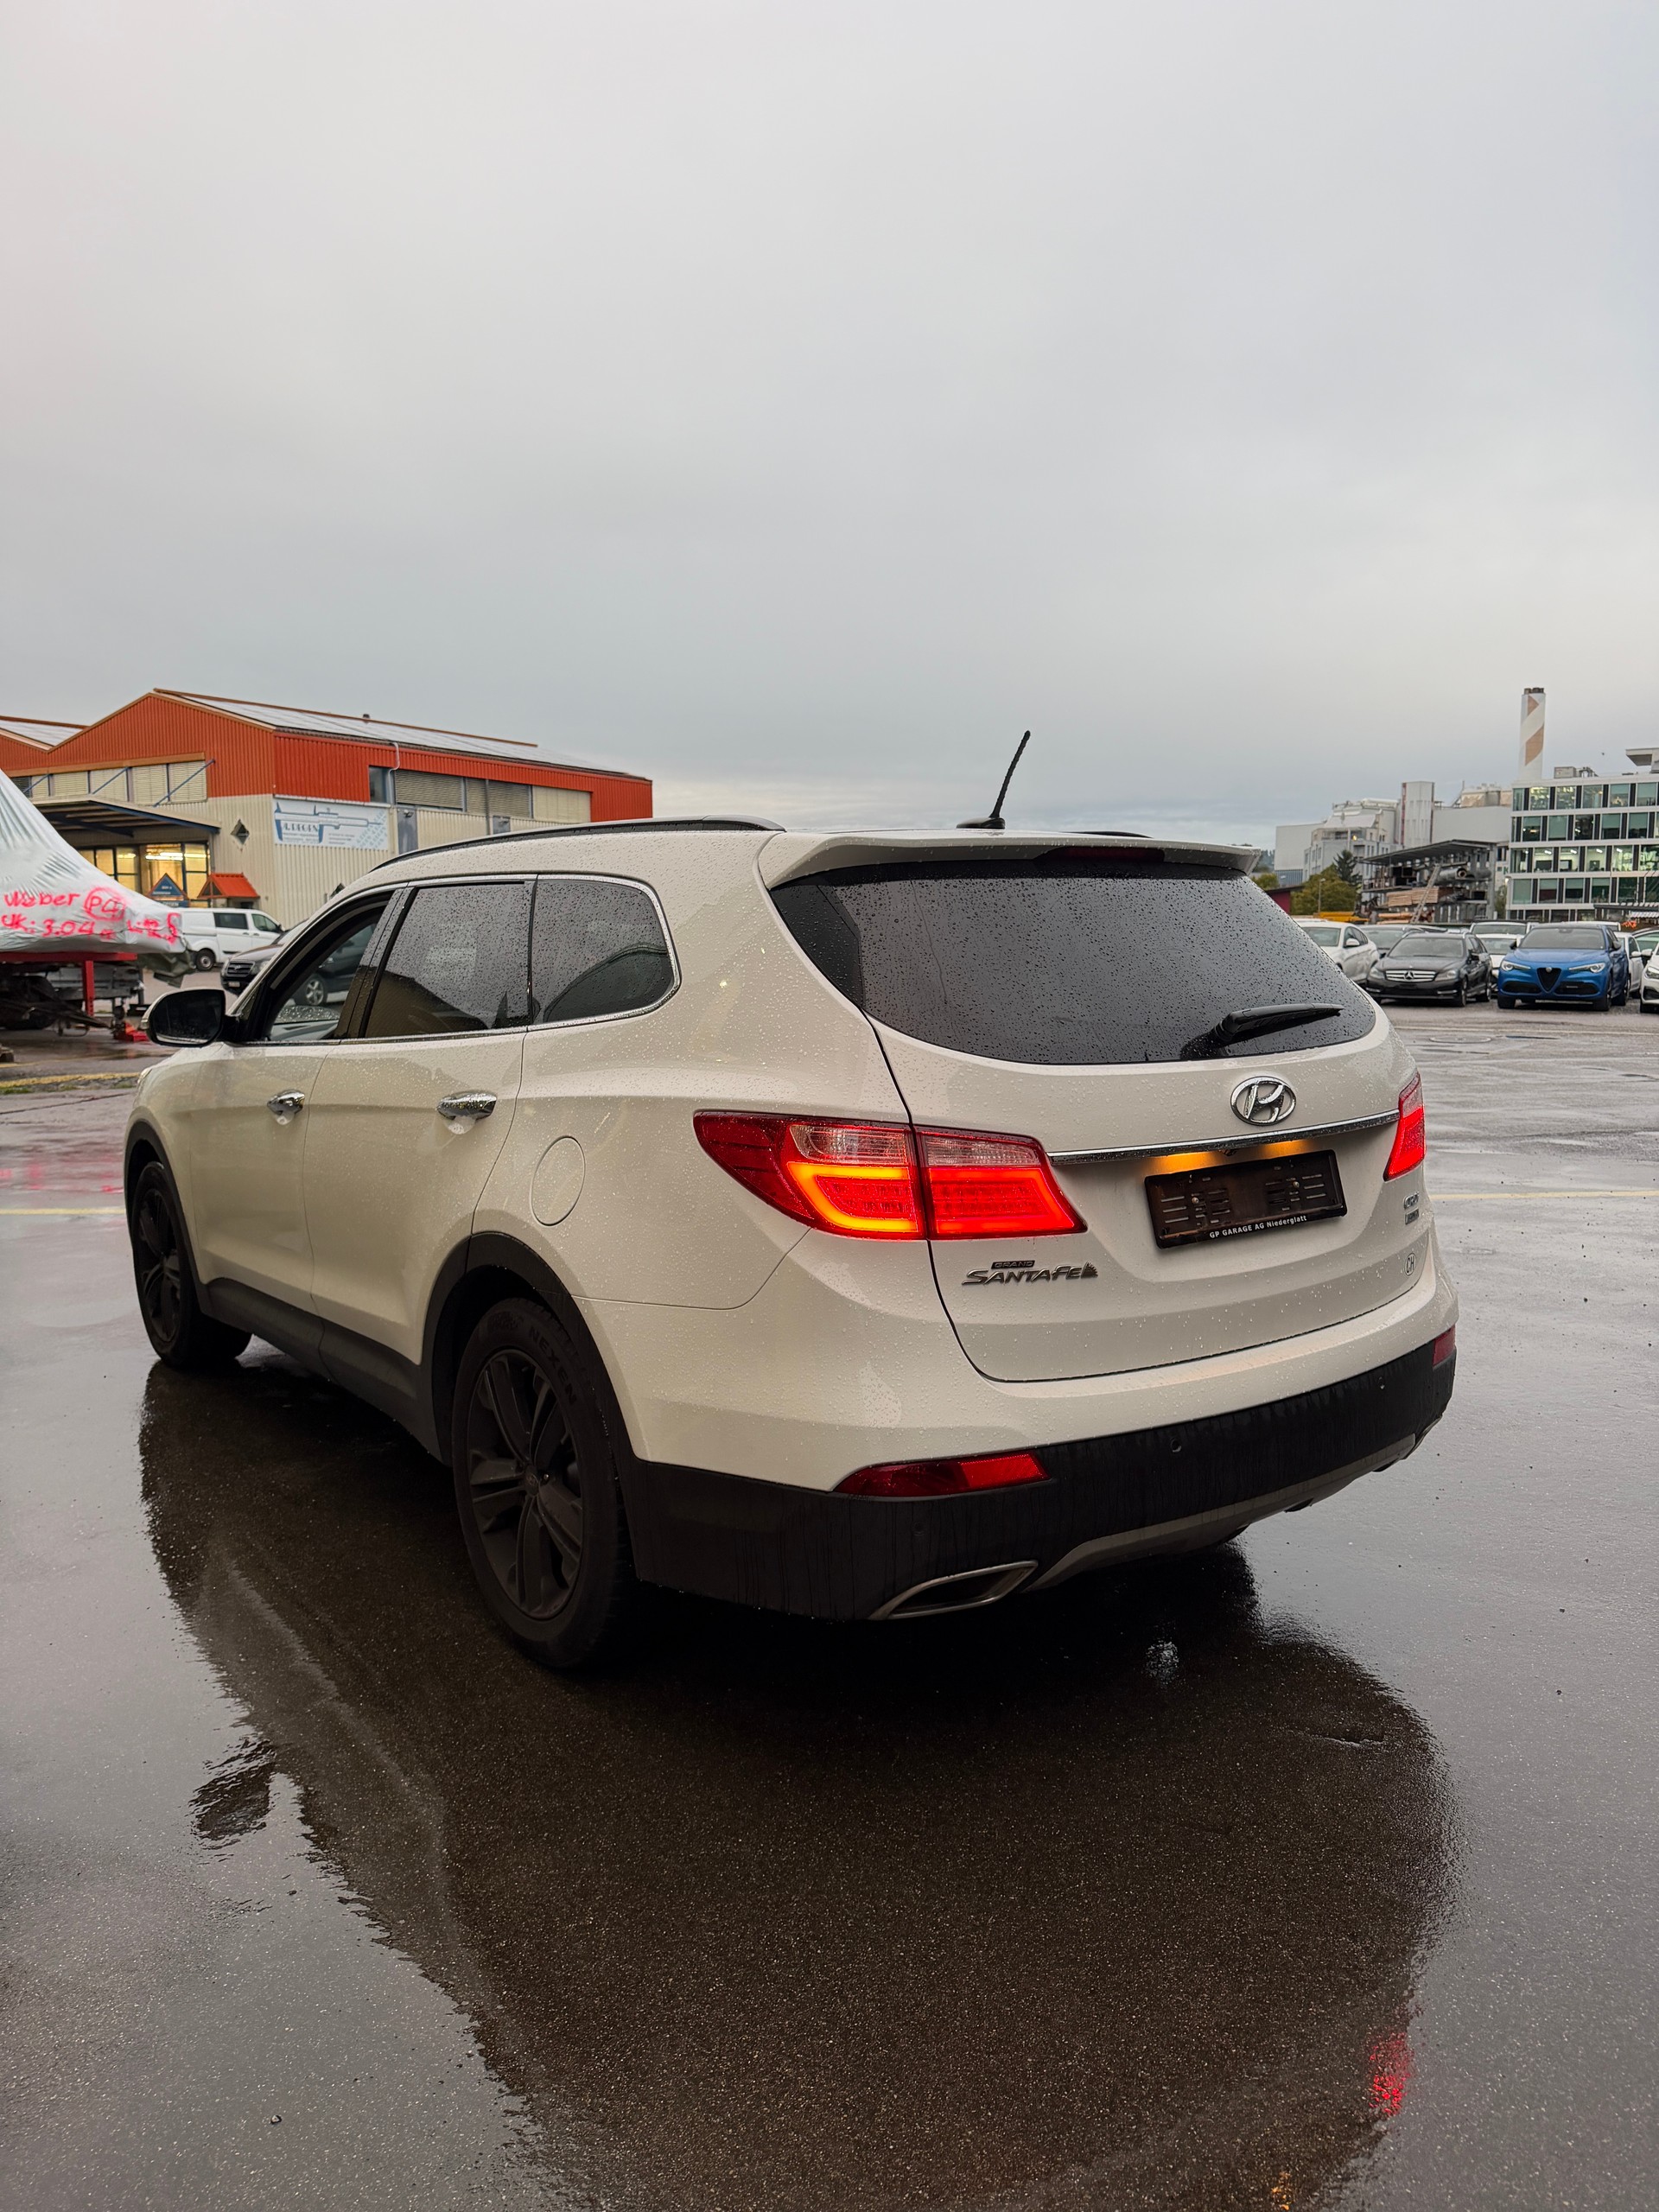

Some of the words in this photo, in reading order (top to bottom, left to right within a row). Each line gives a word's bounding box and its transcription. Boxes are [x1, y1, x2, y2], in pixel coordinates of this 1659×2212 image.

[1222, 1224, 1253, 1236] GARAGE
[1266, 1215, 1307, 1228] Niederglatt
[1406, 1255, 1415, 1274] CH
[530, 1326, 577, 1405] NEXEN
